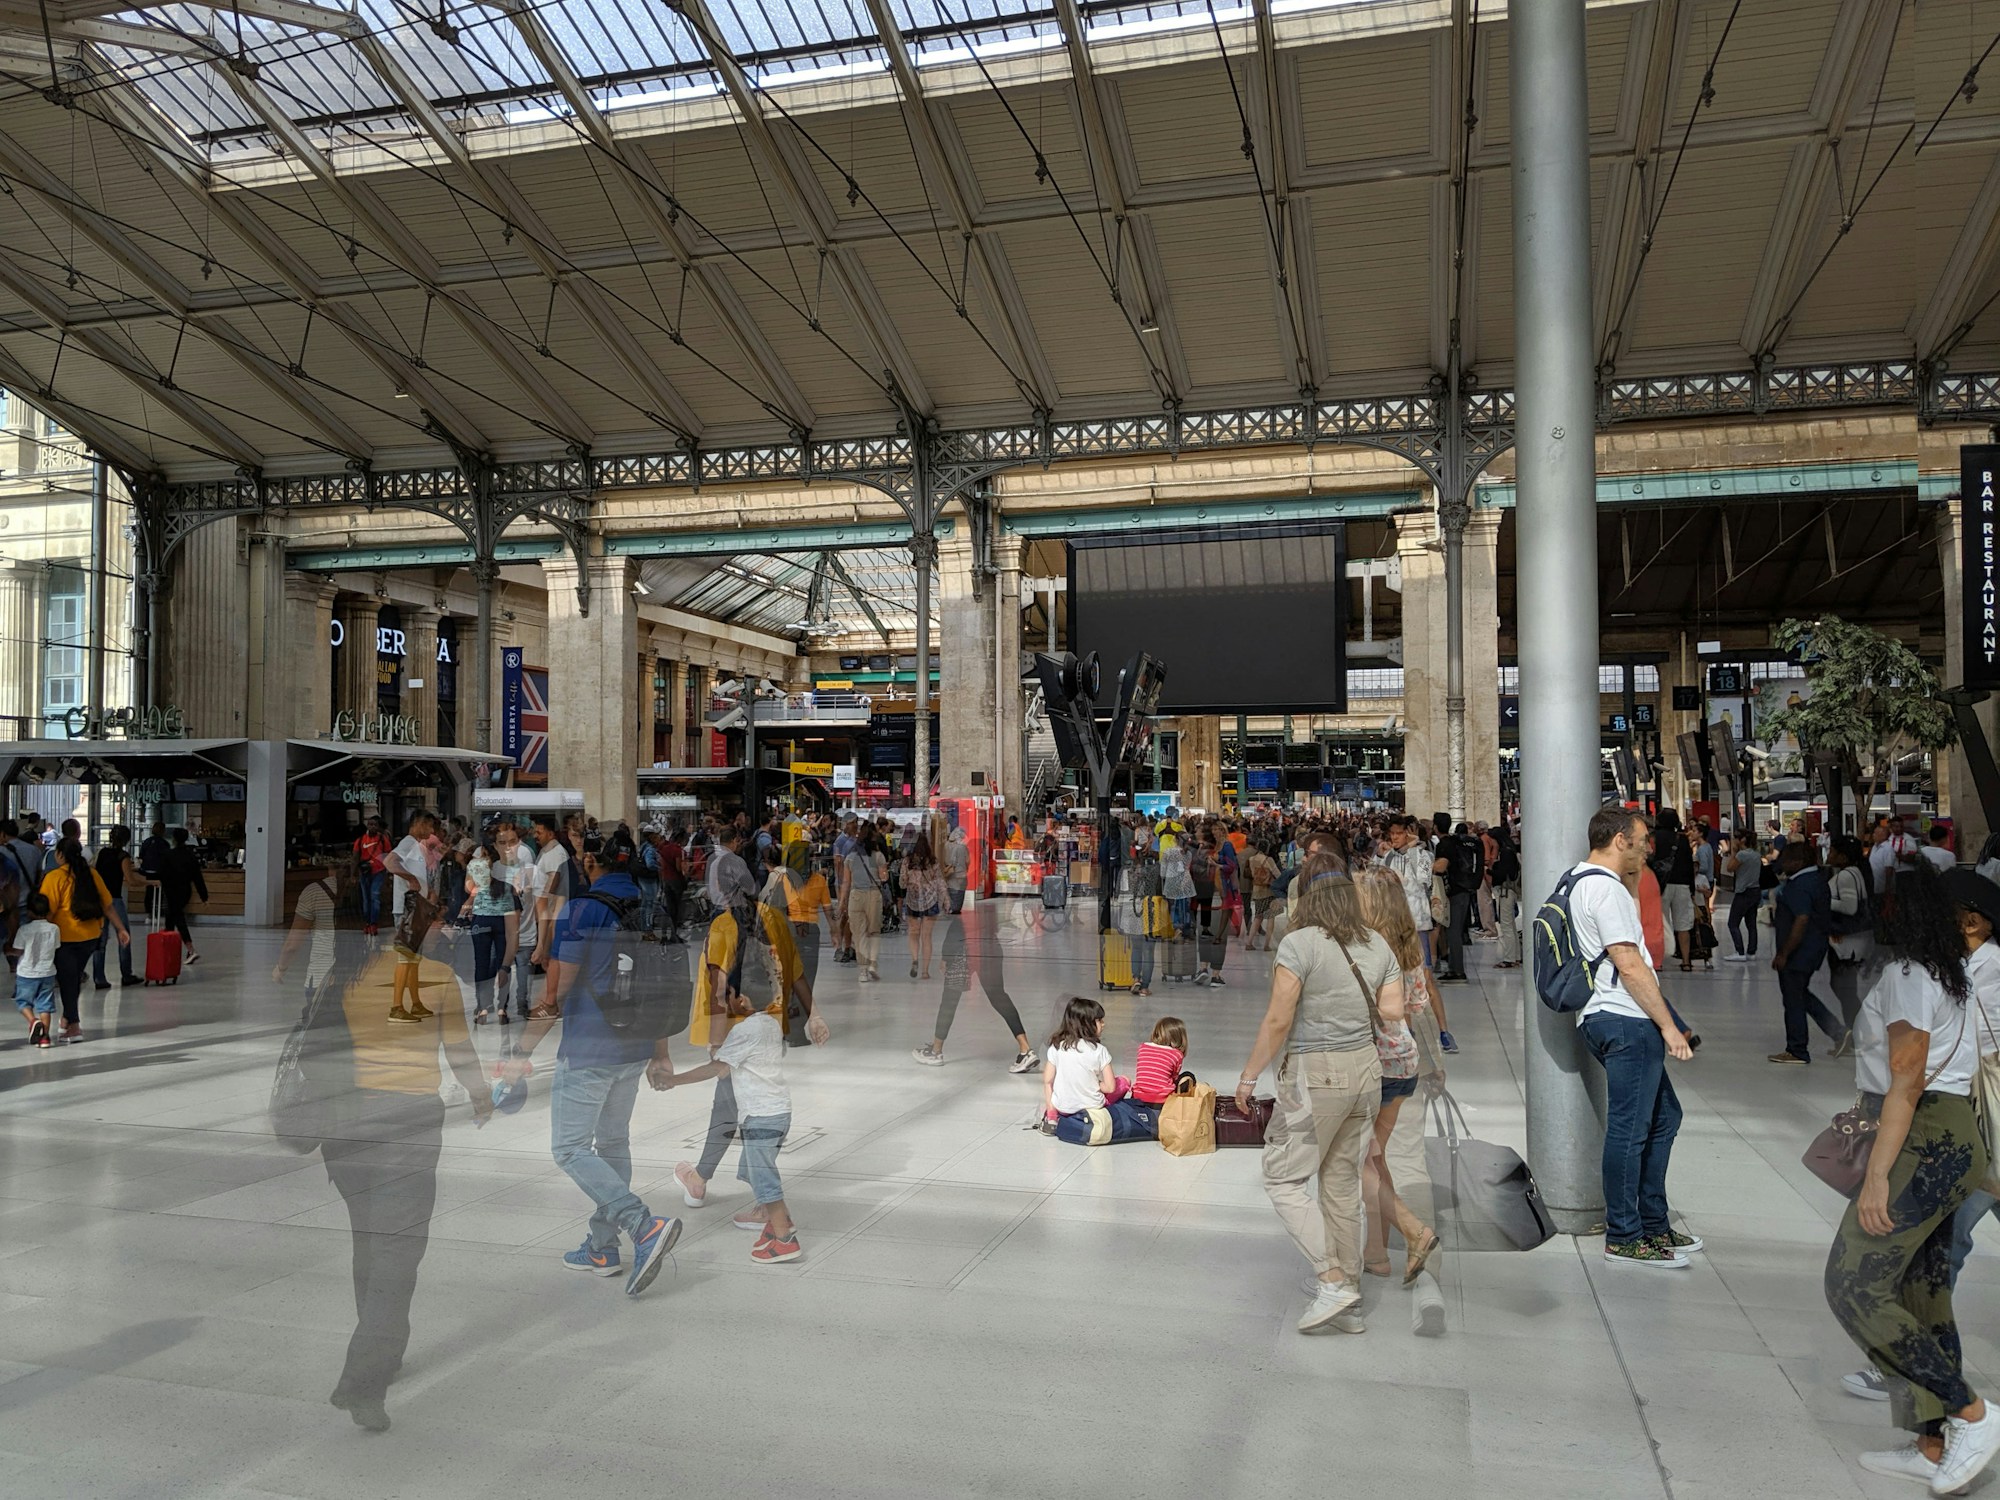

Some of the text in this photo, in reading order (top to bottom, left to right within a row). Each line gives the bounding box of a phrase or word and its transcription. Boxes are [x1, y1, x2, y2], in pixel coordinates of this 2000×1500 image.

[1981, 471, 1996, 663] BAR RESTAURANT
[1716, 676, 1735, 689] 18
[1680, 694, 1695, 705] 17
[1636, 711, 1650, 721] 16
[1613, 720, 1626, 729] 15
[805, 766, 831, 774] Alarme
